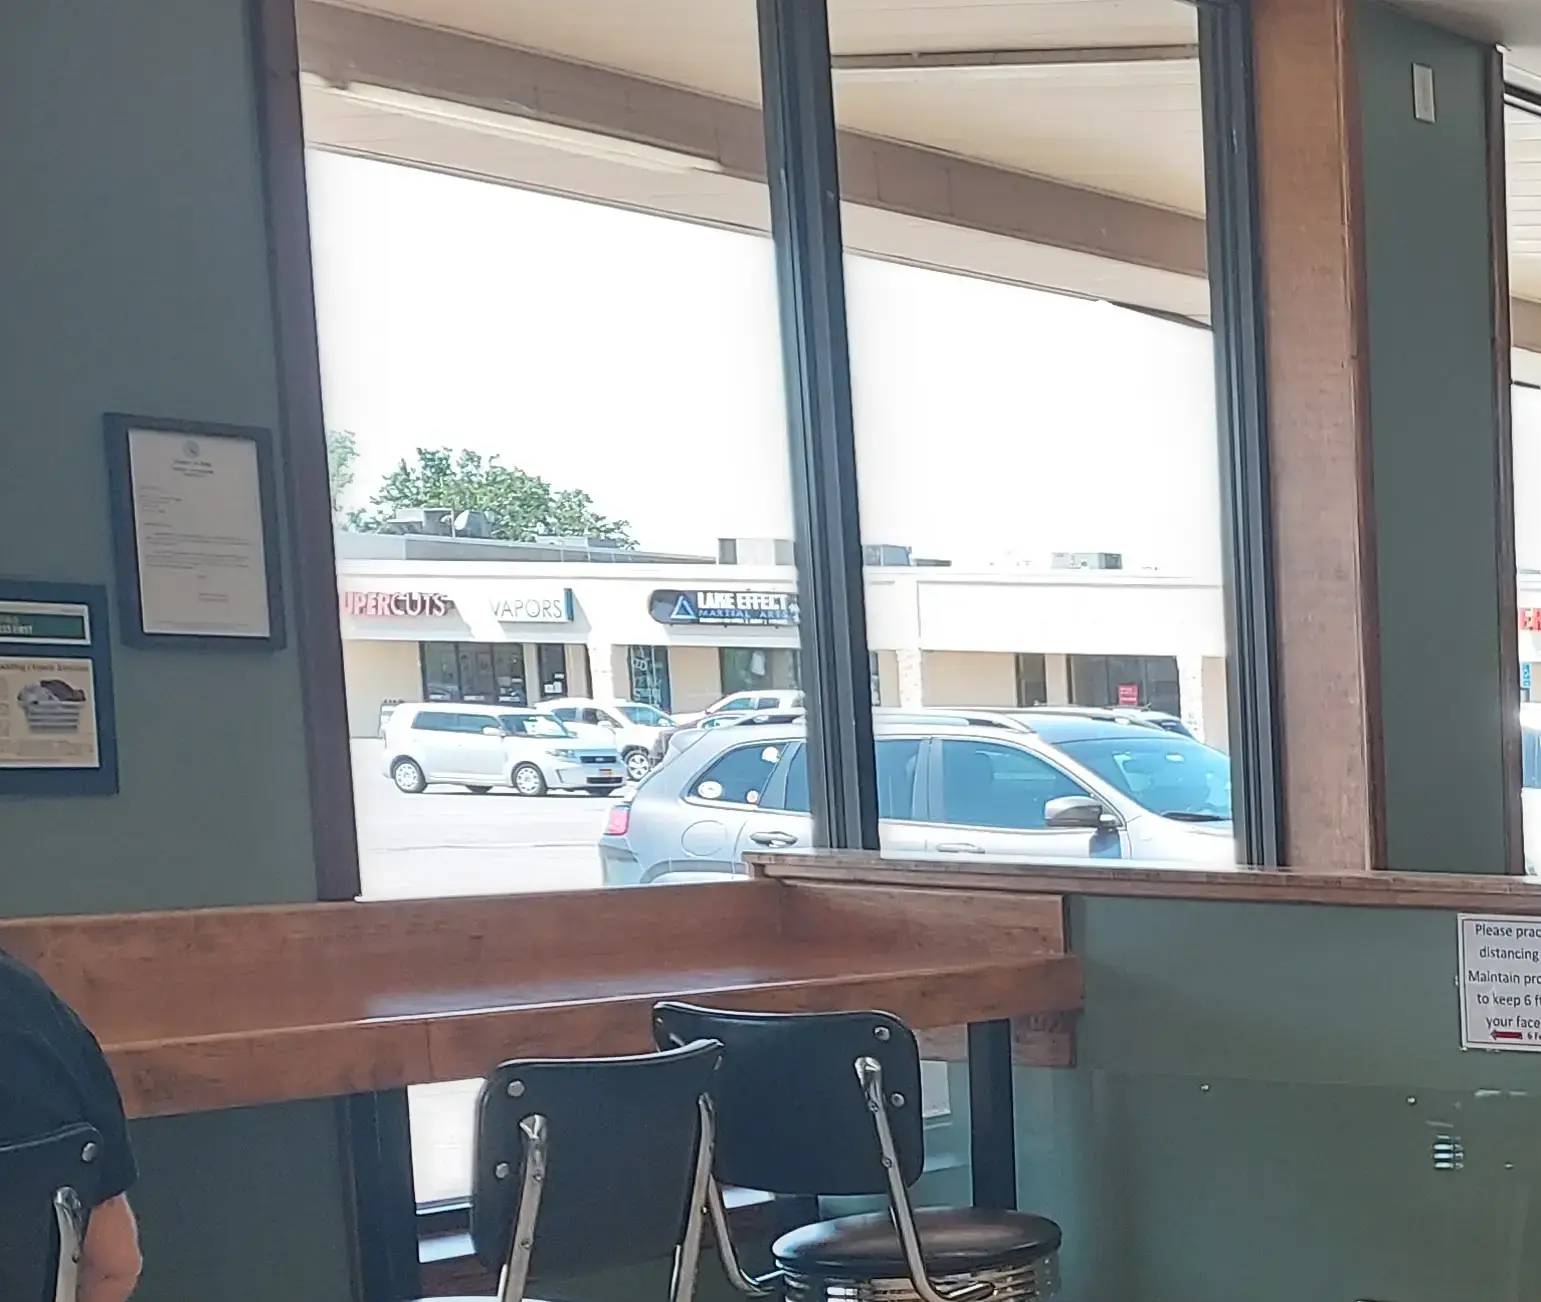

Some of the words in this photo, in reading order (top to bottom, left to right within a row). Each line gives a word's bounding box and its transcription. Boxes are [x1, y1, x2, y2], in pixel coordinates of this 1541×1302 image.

[697, 592, 735, 608] LAKE
[736, 593, 787, 610] EFFECT
[490, 598, 562, 619] VAPORS
[699, 608, 751, 618] MARTIAL
[760, 610, 789, 618] ARTS
[1475, 924, 1513, 936] Please
[1479, 946, 1539, 963] distancing
[1468, 970, 1520, 984] Maintain
[1477, 993, 1489, 1004] to
[1493, 992, 1521, 1007] keep
[1524, 995, 1532, 1006] 6
[1486, 1017, 1513, 1028] your
[1516, 1016, 1540, 1028] face
